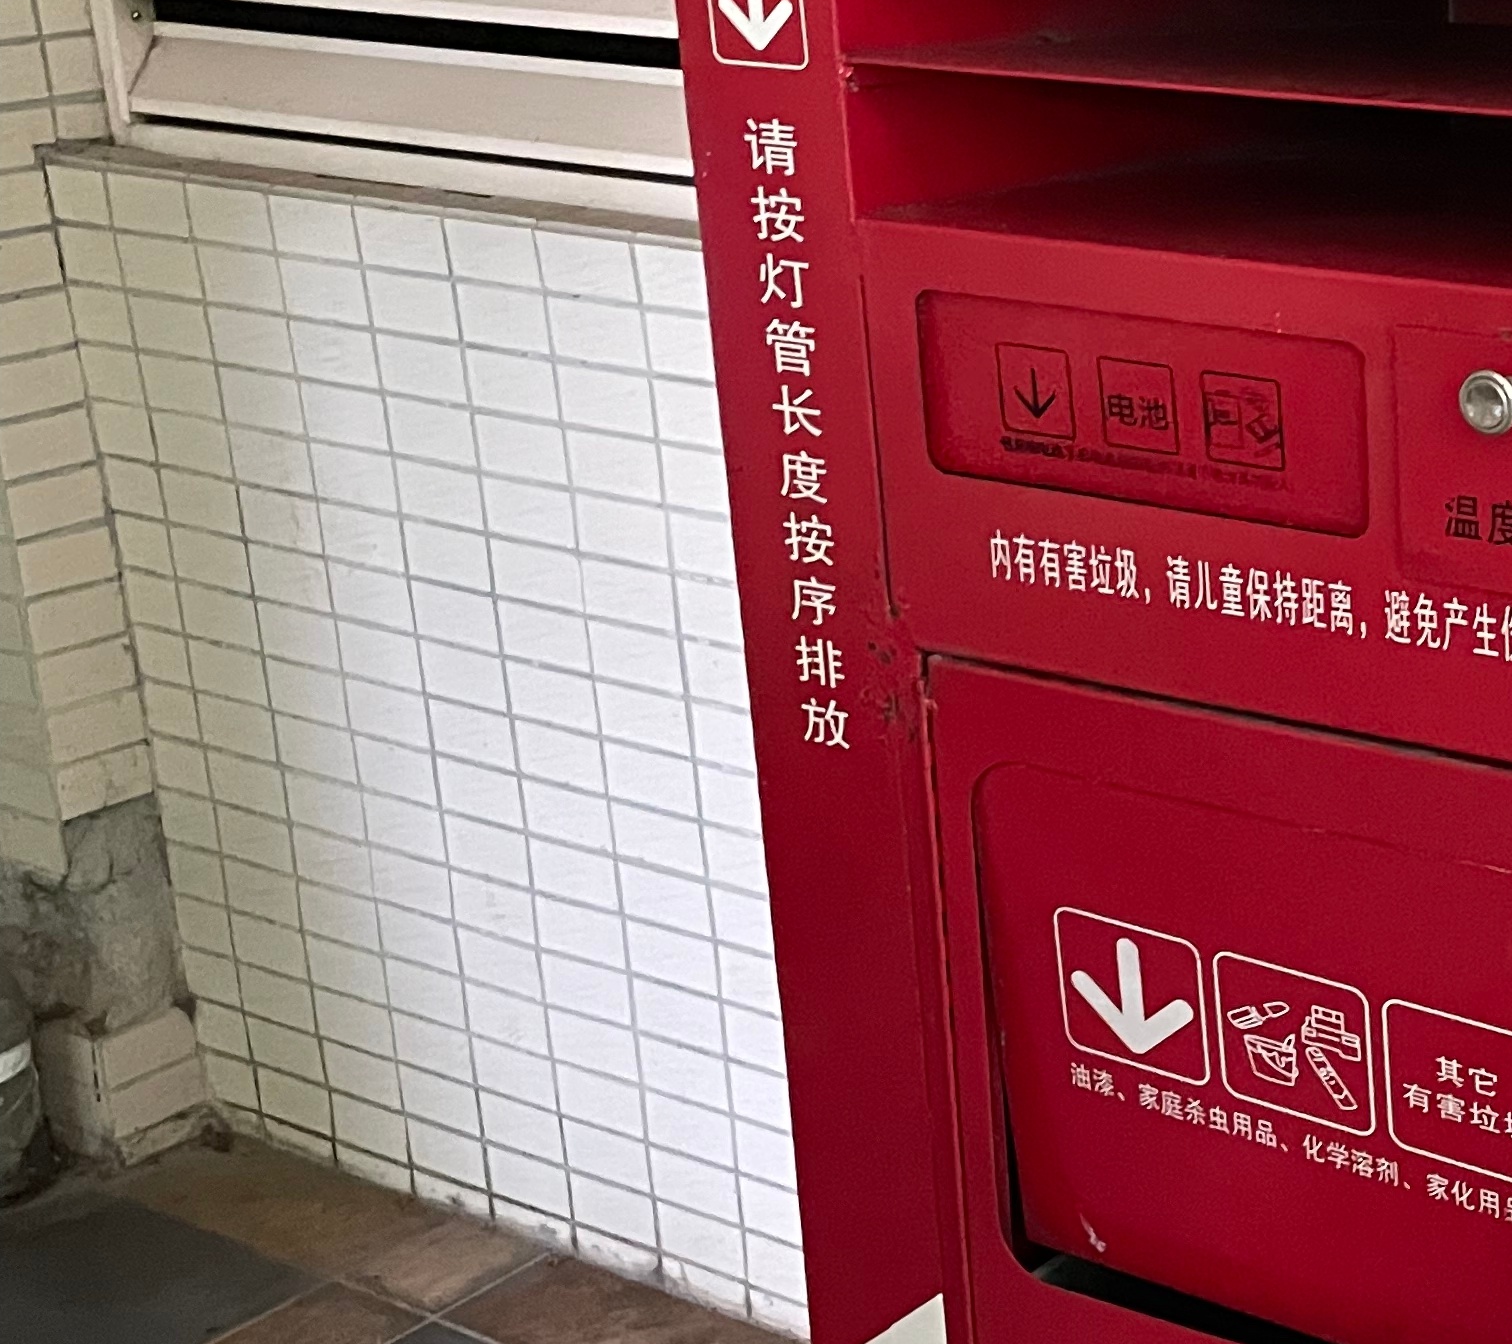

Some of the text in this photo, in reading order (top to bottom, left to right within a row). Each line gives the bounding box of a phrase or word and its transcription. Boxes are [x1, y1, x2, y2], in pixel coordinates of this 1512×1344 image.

[743, 117, 850, 750] 请按灯管长度按序排放
[1107, 393, 1169, 432] 电池
[1435, 1055, 1498, 1098] 其它
